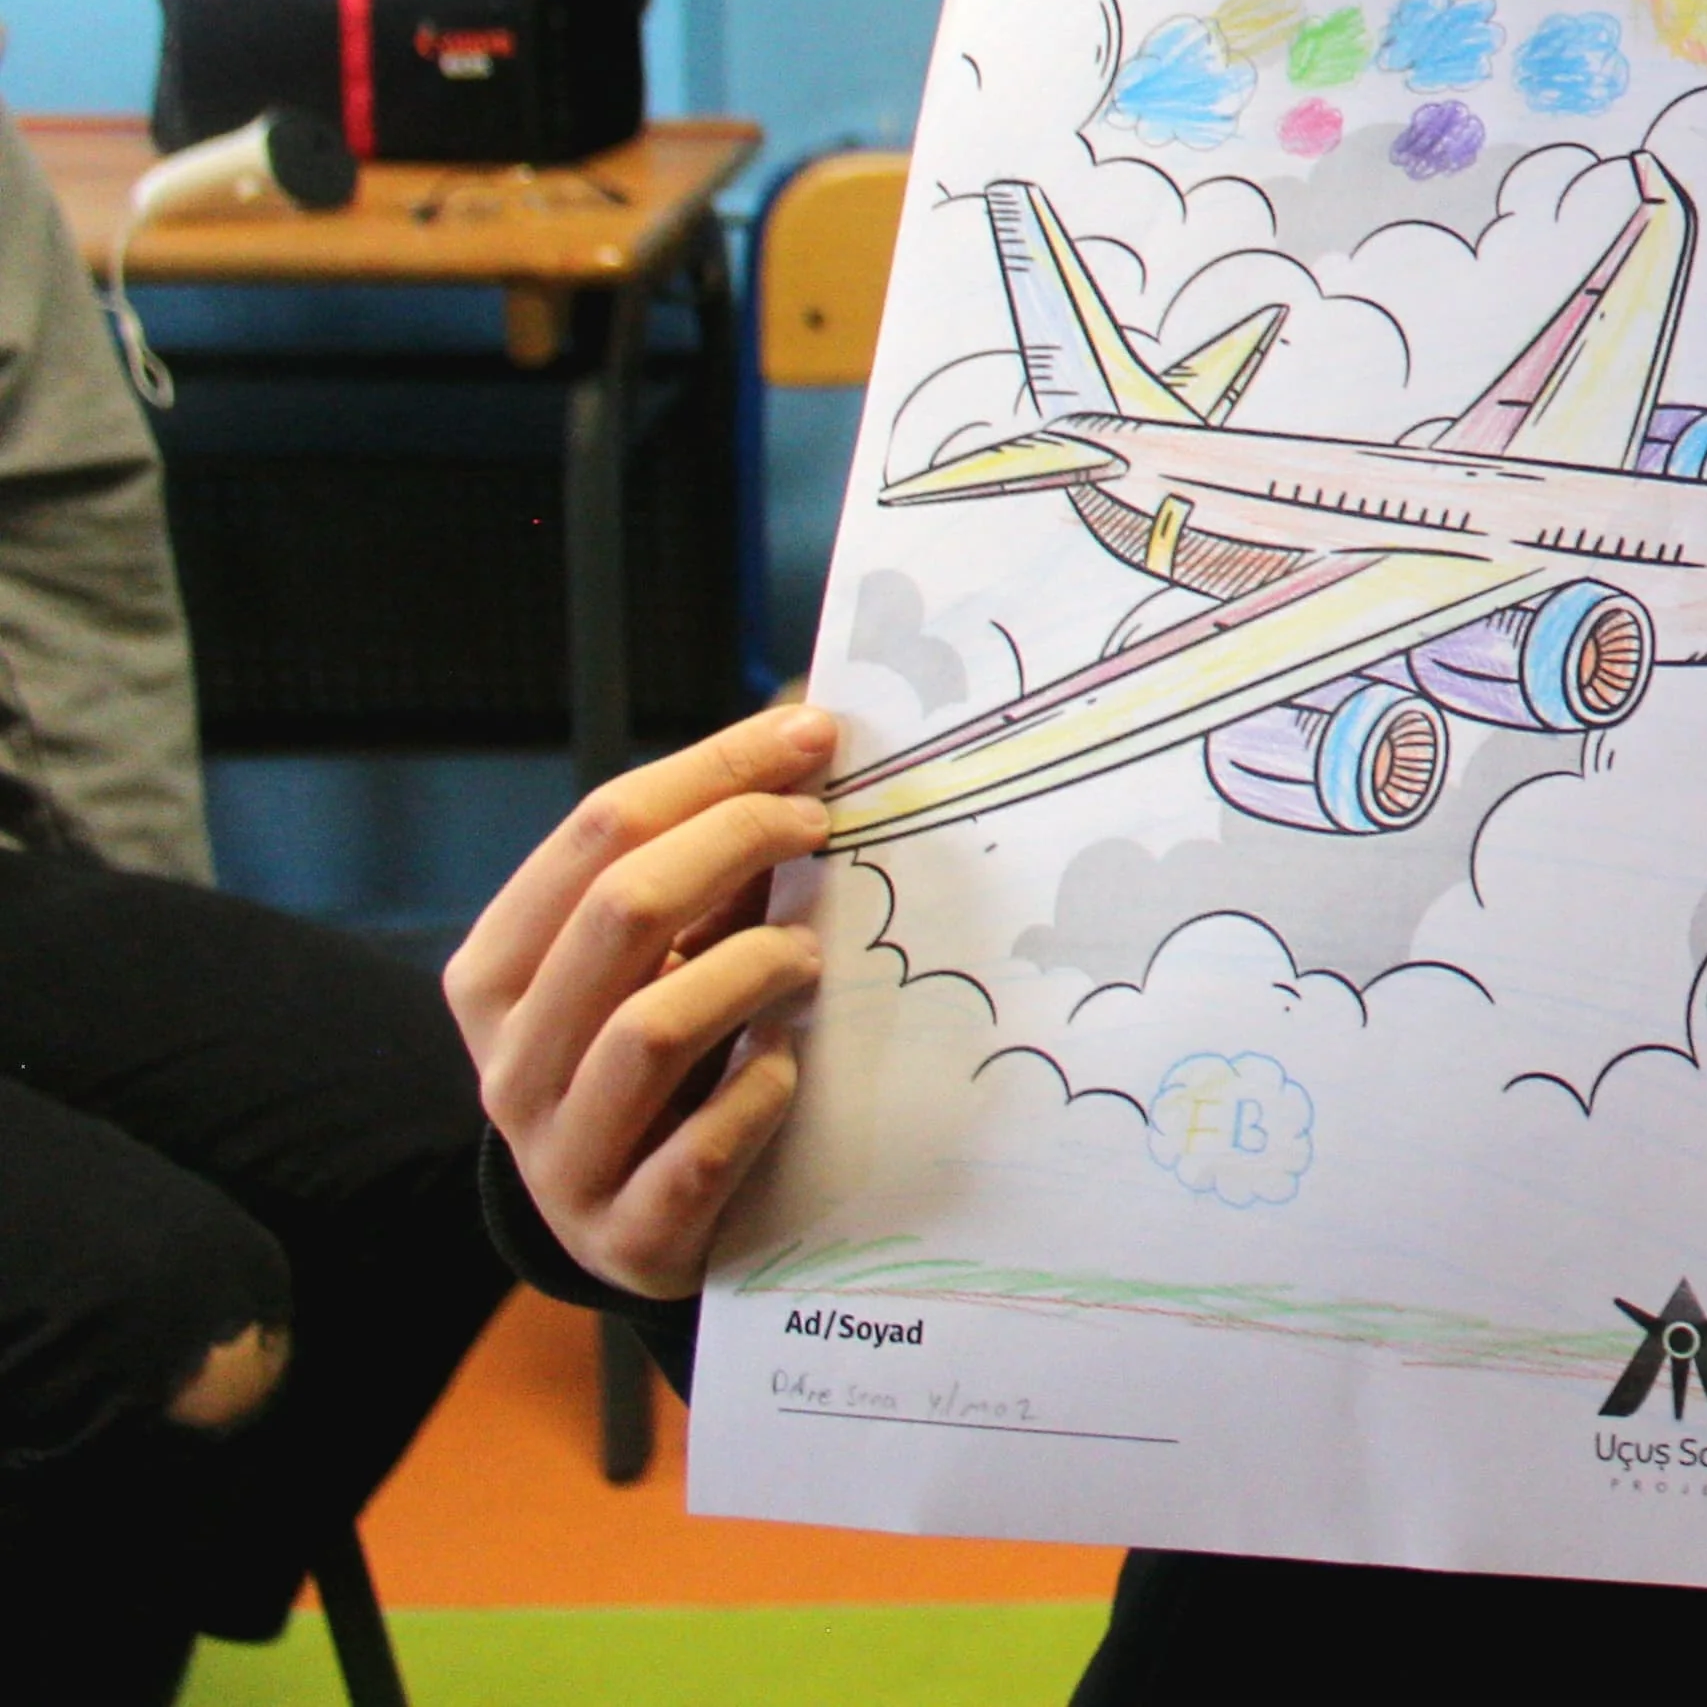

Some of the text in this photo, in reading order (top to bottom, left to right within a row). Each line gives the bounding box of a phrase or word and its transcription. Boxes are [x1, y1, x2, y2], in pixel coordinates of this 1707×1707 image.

[1184, 1098, 1269, 1154] FB
[784, 1309, 925, 1349] Ad/Soyad
[1594, 1432, 1671, 1472] Uçuş
